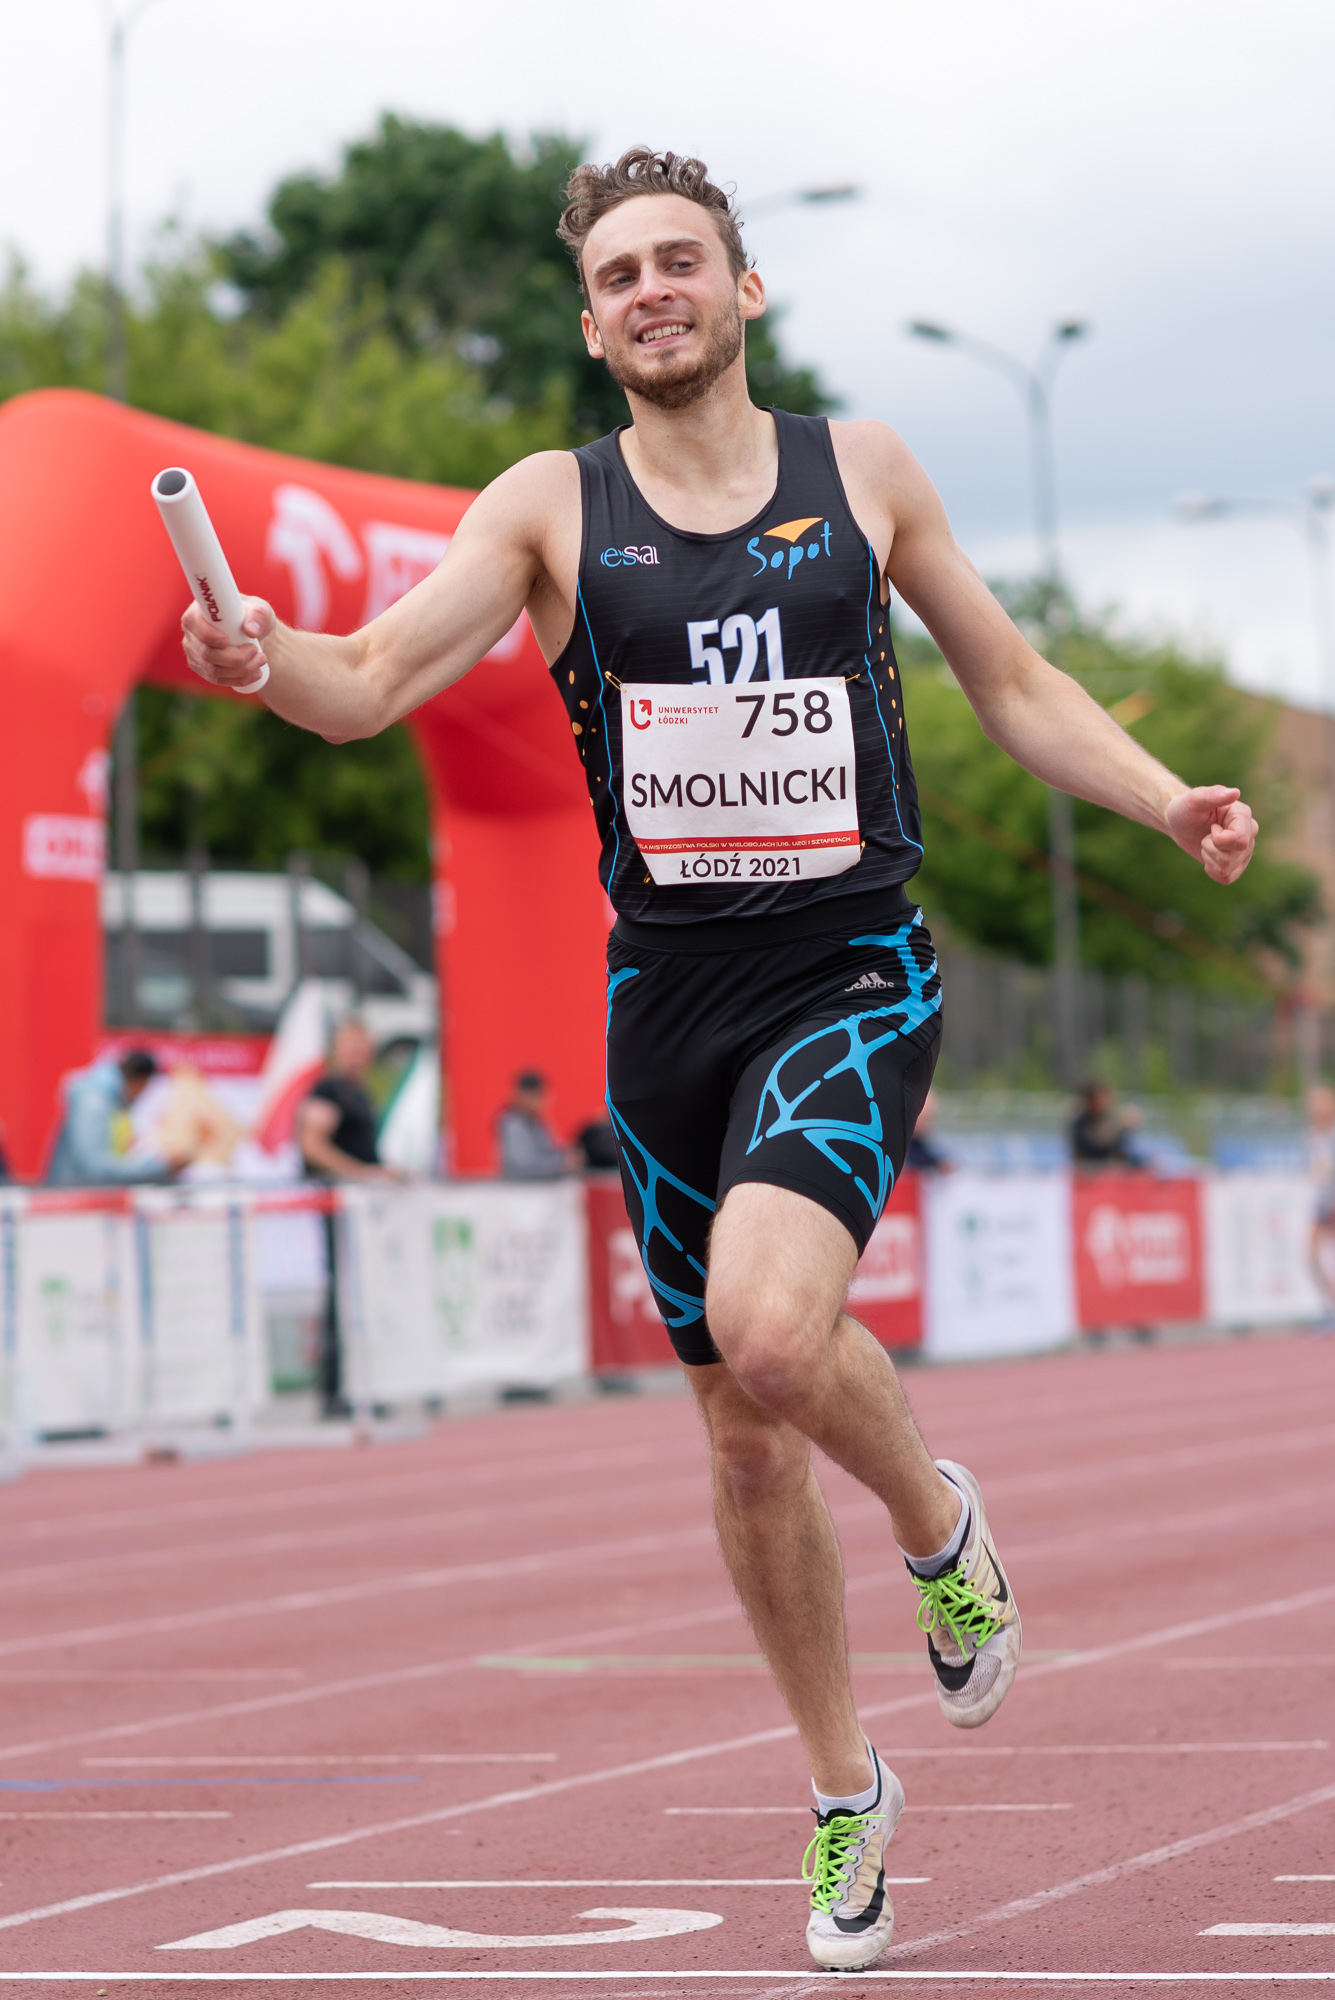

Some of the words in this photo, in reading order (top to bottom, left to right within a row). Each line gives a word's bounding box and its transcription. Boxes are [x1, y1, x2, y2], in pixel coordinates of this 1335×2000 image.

[600, 545, 660, 568] esa
[746, 521, 833, 580] Sopot
[197, 577, 222, 622] POLANIK
[686, 606, 785, 685] 521
[658, 706, 719, 714] UNIWERSYTET
[658, 715, 688, 725] ŁÓDZKI
[735, 690, 834, 739] 758
[631, 766, 847, 809] SMOLNICKI
[680, 853, 742, 879] ŁÓDŹ
[749, 857, 801, 878] 2021
